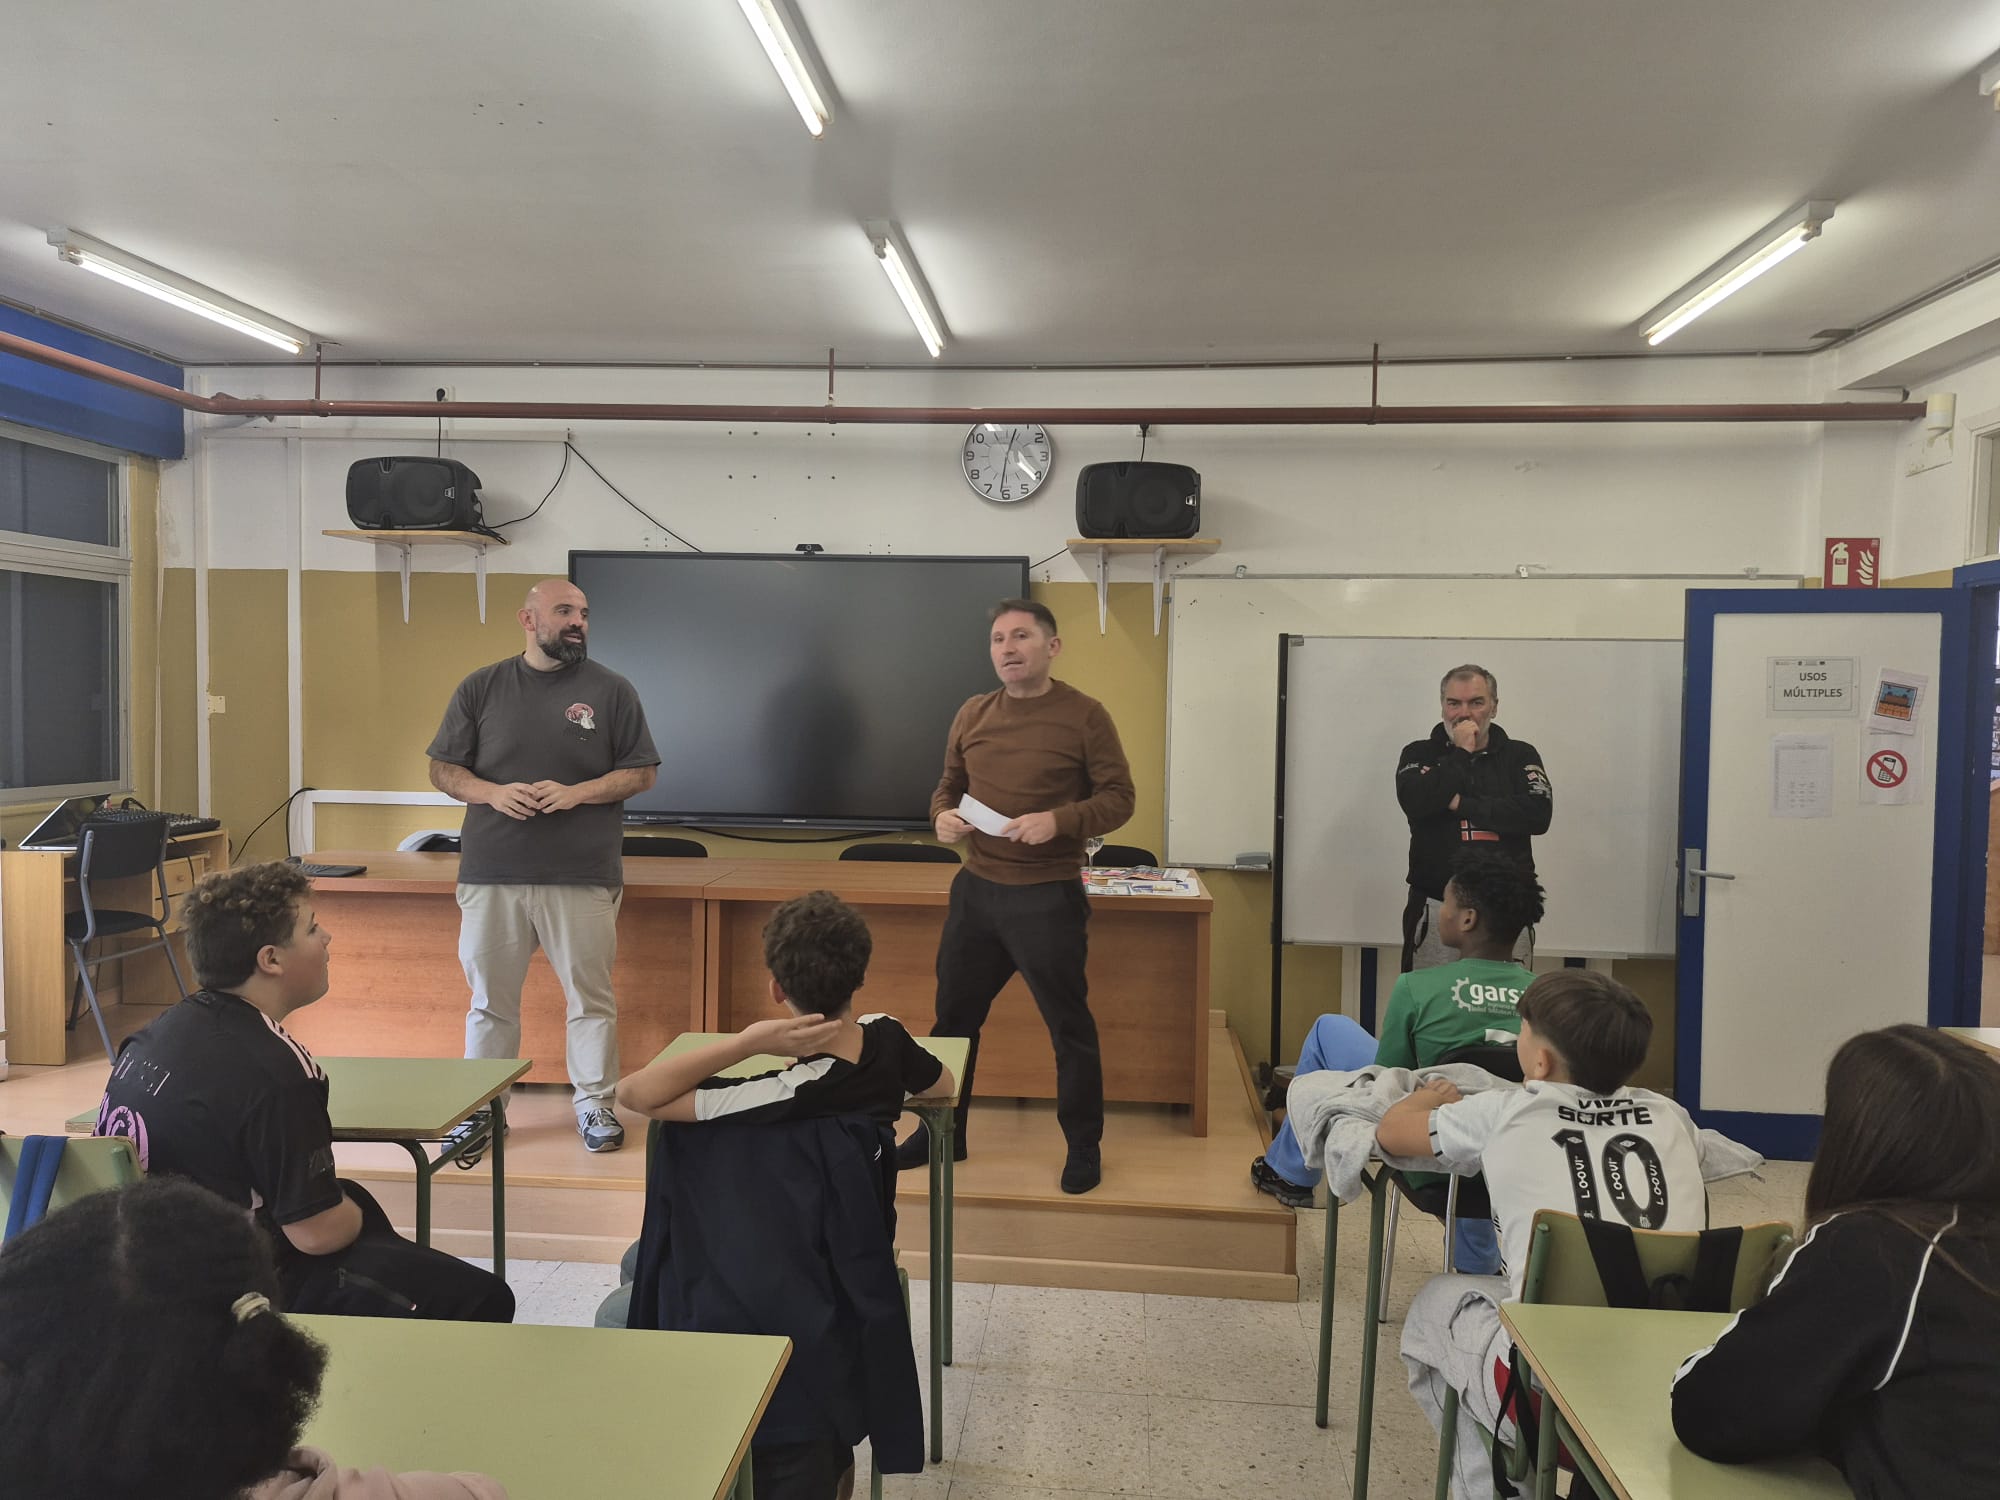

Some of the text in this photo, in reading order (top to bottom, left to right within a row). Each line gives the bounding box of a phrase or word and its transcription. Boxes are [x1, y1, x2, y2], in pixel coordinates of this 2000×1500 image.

[971, 433, 985, 444] 10
[1034, 432, 1044, 443] 2
[965, 450, 975, 461] 9
[1040, 451, 1048, 461] 3
[970, 469, 980, 480] 8
[984, 484, 993, 494] 7
[1001, 489, 1010, 500] 6
[1020, 484, 1029, 494] 5
[1799, 672, 1828, 681] USOS
[1783, 686, 1843, 698] MÚLTIPLES
[1469, 984, 1525, 1006] gars
[1558, 1105, 1653, 1126] SORTE
[1551, 1128, 1669, 1230] 10
[1574, 1158, 1591, 1199] LOOVI
[1608, 1160, 1626, 1201] LOOVI
